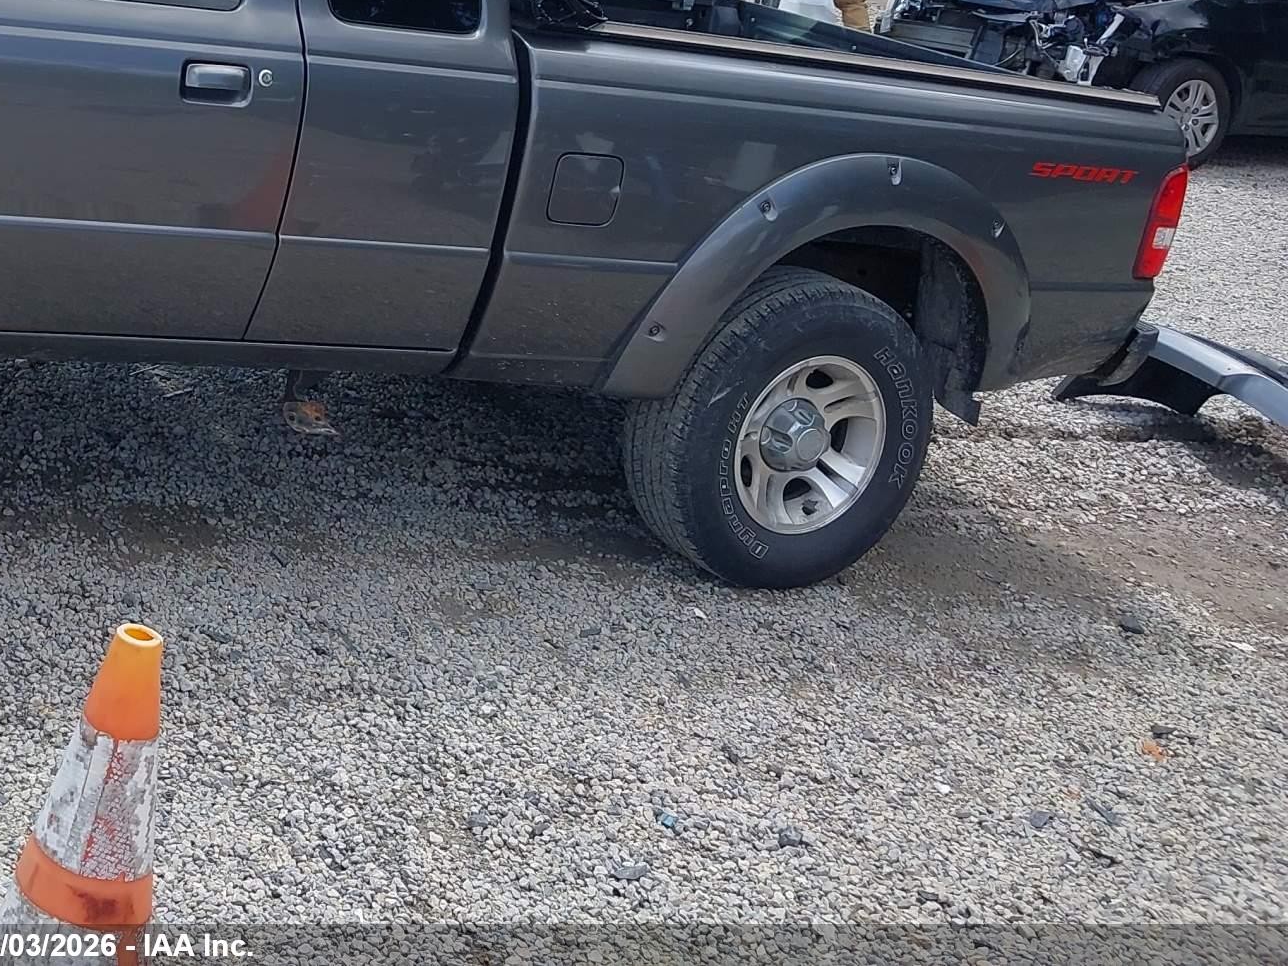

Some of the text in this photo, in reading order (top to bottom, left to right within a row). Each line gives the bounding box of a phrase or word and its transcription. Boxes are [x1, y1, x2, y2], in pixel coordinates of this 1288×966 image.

[1028, 162, 1140, 185] SPORT
[718, 391, 769, 560] Dynapro HT
